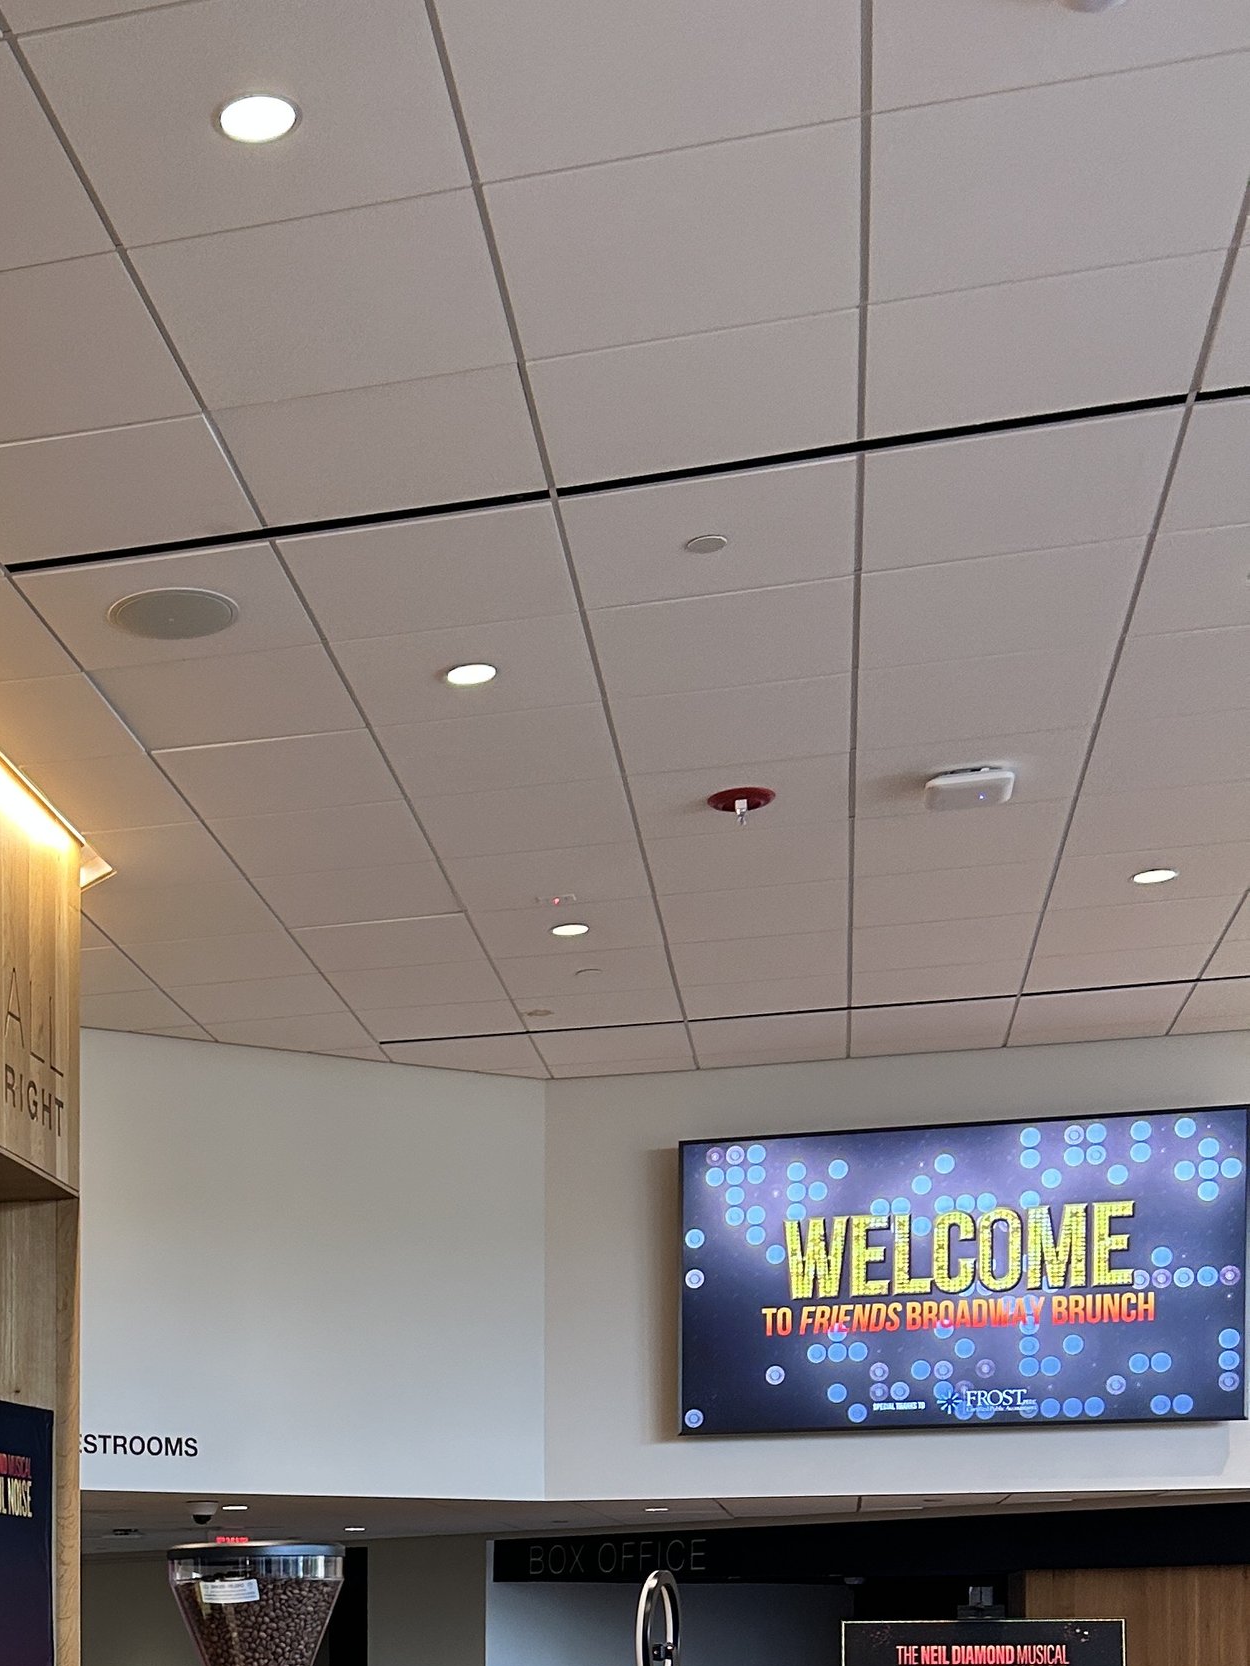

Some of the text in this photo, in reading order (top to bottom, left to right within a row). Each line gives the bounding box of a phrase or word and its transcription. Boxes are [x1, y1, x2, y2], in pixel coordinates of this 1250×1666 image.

[4, 1063, 64, 1138] RIGHT
[783, 1199, 1136, 1300] WELCOME
[761, 1291, 1156, 1336] TO FRIENDS BROADWAY BRUNCH
[966, 1388, 1028, 1406] FROST
[79, 1433, 199, 1457] STROOMS
[7, 1477, 33, 1518] NOISE
[529, 1538, 707, 1575] BOX OFFICE
[896, 1644, 1070, 1665] THE NEIL DIAMOND MUSICAL
